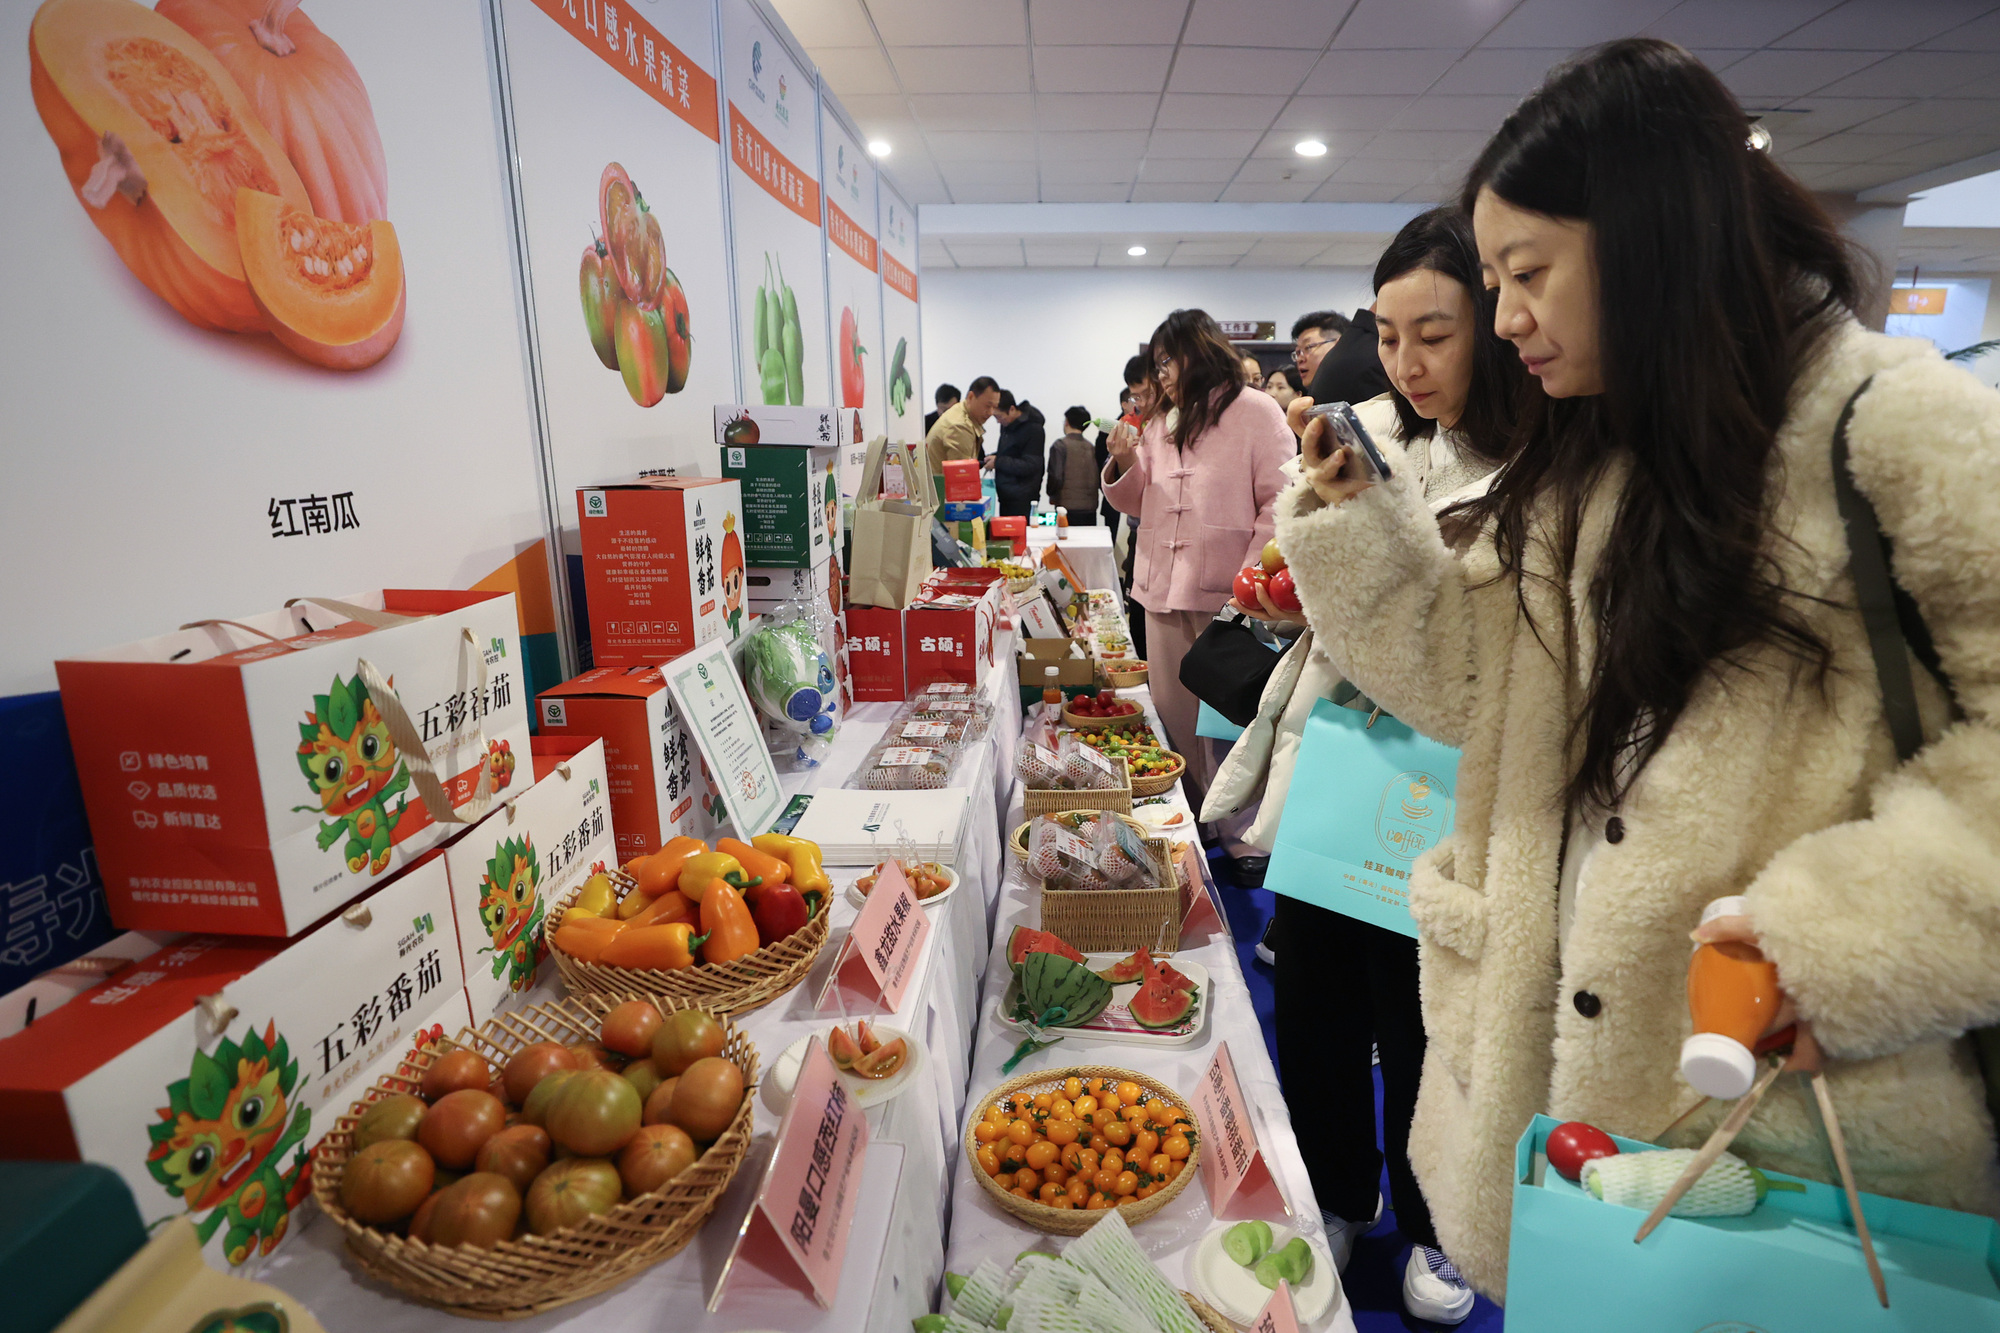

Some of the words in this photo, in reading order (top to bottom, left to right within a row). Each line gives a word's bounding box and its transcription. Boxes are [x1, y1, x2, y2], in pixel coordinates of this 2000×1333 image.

[736, 123, 804, 208] 寿光口感水果蔬菜
[267, 491, 360, 538] 红南瓜
[847, 636, 881, 652] 古硕
[920, 637, 954, 652] 古硕
[417, 673, 511, 744] 五彩番茄
[148, 753, 209, 771] 绿色培育
[157, 782, 217, 801] 品质优选
[163, 811, 222, 830] 新鲜直达
[546, 806, 604, 881] 五彩番茄
[874, 891, 912, 974] 鑫龙甜水果椒
[313, 949, 442, 1081] 五彩番茄
[790, 1080, 847, 1257] 阳曼口感西红柿
